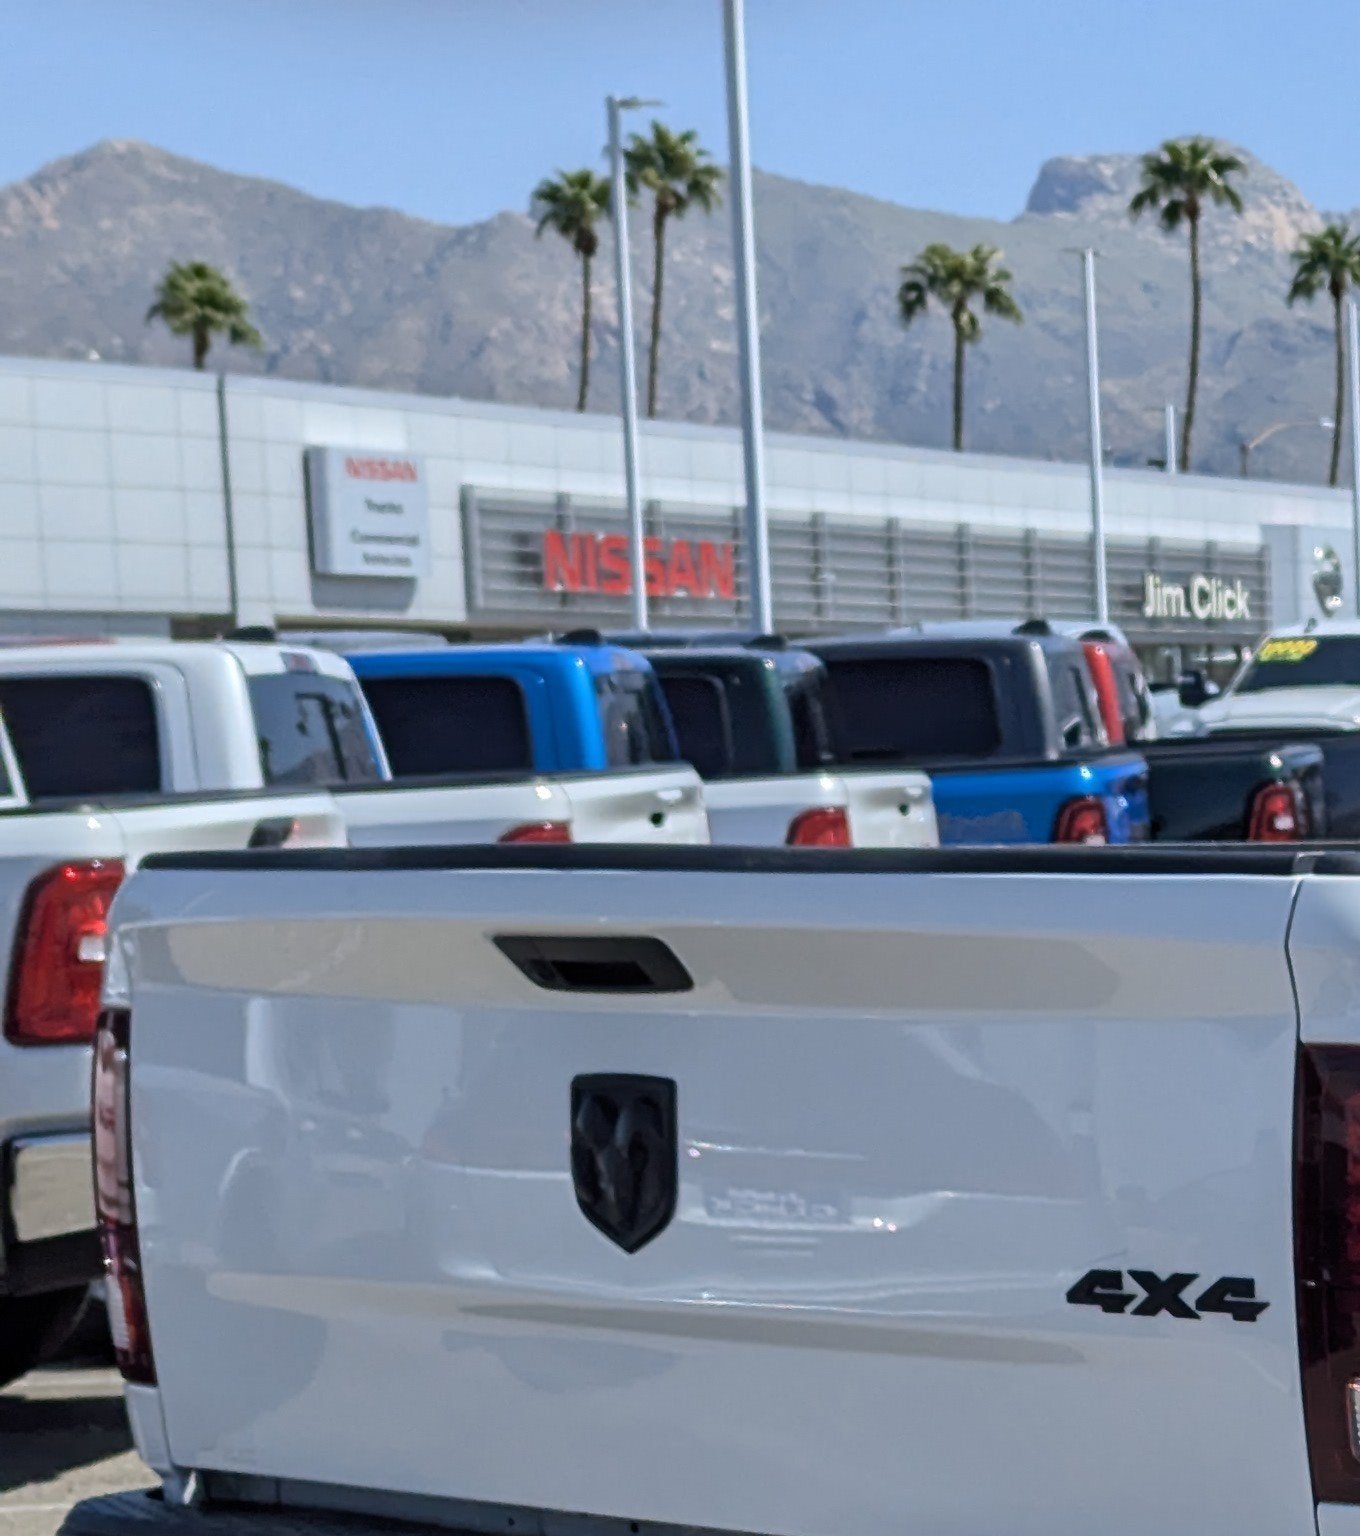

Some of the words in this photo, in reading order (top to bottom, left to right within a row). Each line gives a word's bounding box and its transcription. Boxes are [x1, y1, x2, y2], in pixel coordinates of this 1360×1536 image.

[543, 528, 738, 600] NISSAN
[1144, 572, 1190, 618] Jim
[1190, 575, 1250, 619] Click
